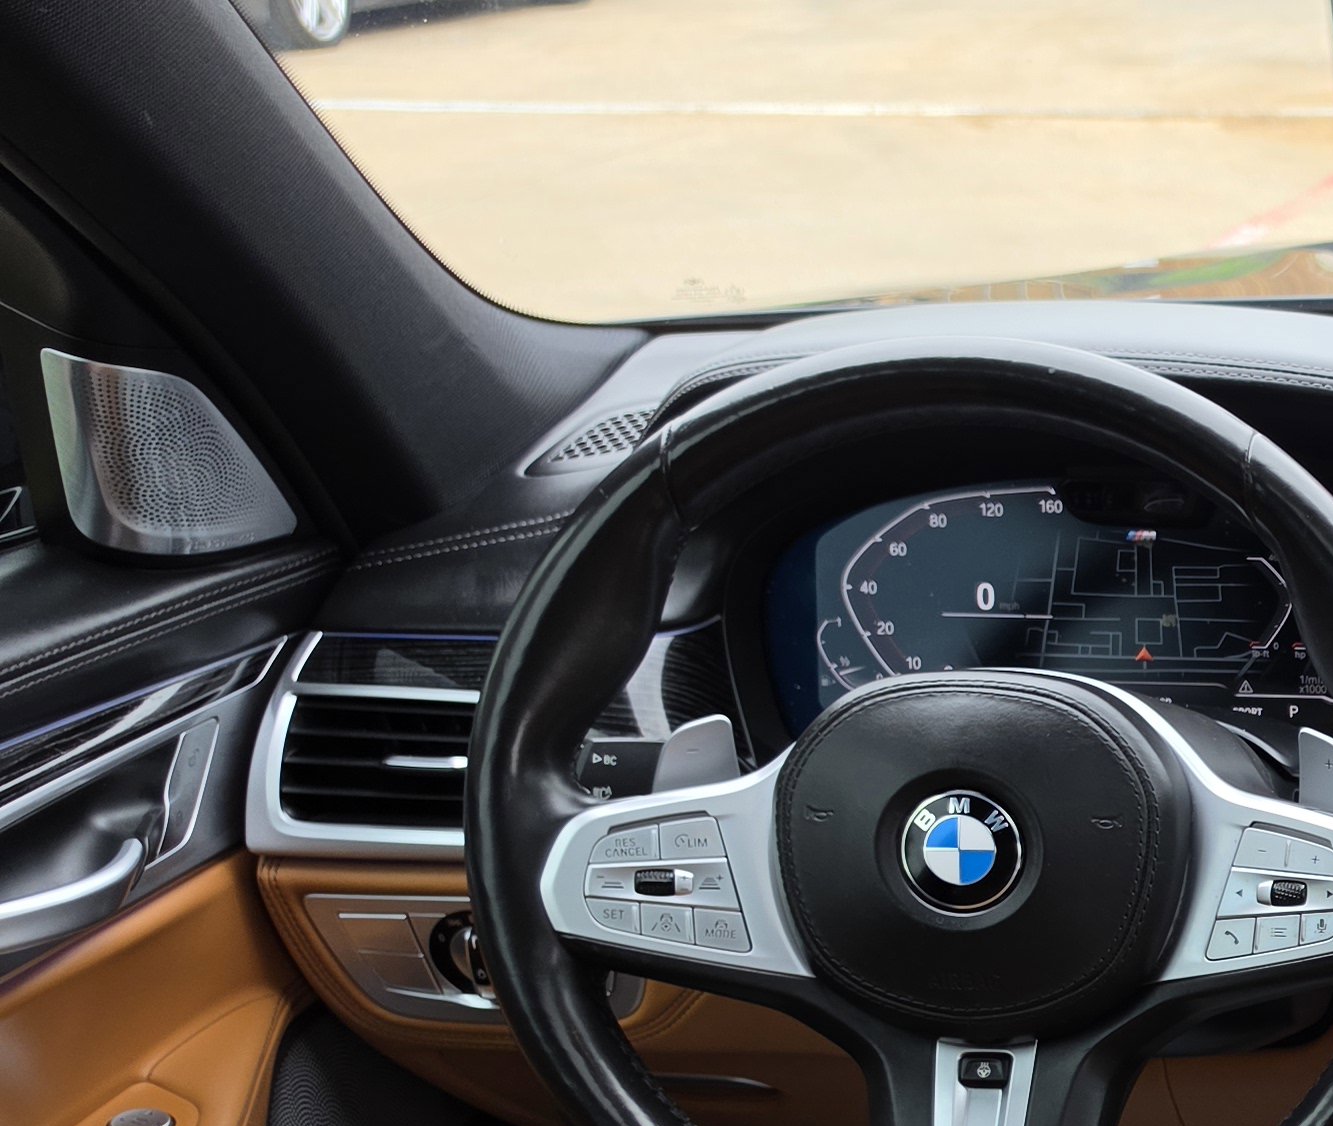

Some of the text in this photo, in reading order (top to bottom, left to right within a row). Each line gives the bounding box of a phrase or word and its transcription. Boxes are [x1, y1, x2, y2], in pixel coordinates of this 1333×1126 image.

[979, 502, 1004, 518] 120
[1039, 499, 1063, 514] 160
[928, 513, 948, 528] 80
[889, 542, 908, 557] 60
[859, 580, 878, 595] 40
[976, 582, 995, 611] 0
[876, 621, 895, 636] 20
[1294, 650, 1307, 660] hp
[905, 656, 922, 670] 10
[1299, 685, 1328, 695] x1000
[1289, 705, 1299, 718] P
[603, 753, 617, 766] BC
[913, 796, 1009, 833] BMW
[614, 837, 636, 847] RES
[687, 837, 708, 848] LIM
[604, 847, 648, 859] CANCEL
[602, 908, 625, 920] SET
[704, 928, 737, 940] MODE
